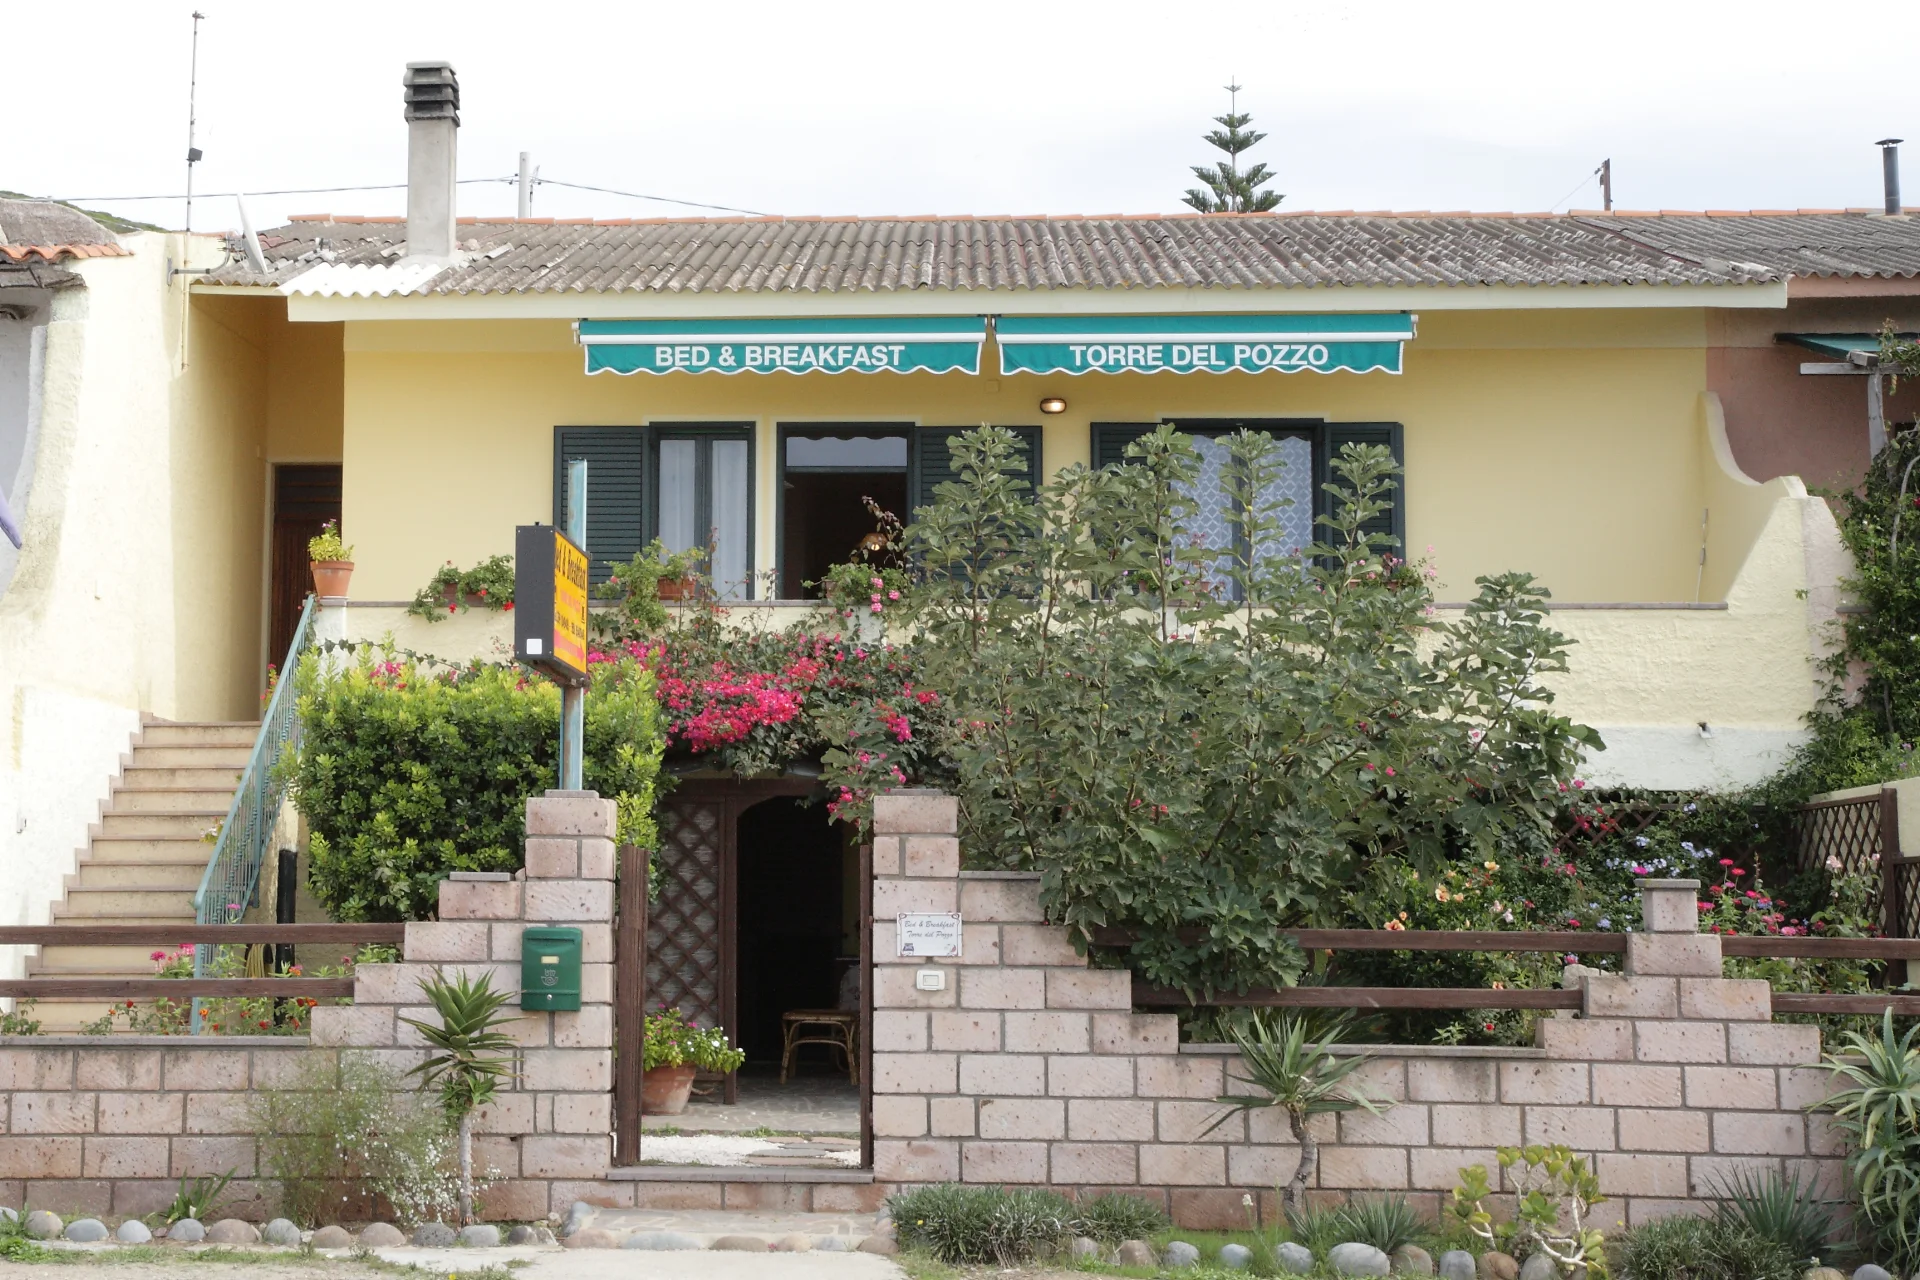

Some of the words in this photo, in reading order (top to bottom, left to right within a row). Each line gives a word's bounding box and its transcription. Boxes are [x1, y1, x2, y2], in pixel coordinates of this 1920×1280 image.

[655, 346, 710, 367] BED
[718, 345, 737, 367] &
[745, 345, 906, 367] BREAKFAST
[1069, 344, 1164, 366] TORRE
[1172, 345, 1226, 366] DEL
[1234, 343, 1329, 366] POZZO
[925, 920, 955, 929] Breakfast
[936, 930, 953, 939] Pozzo
